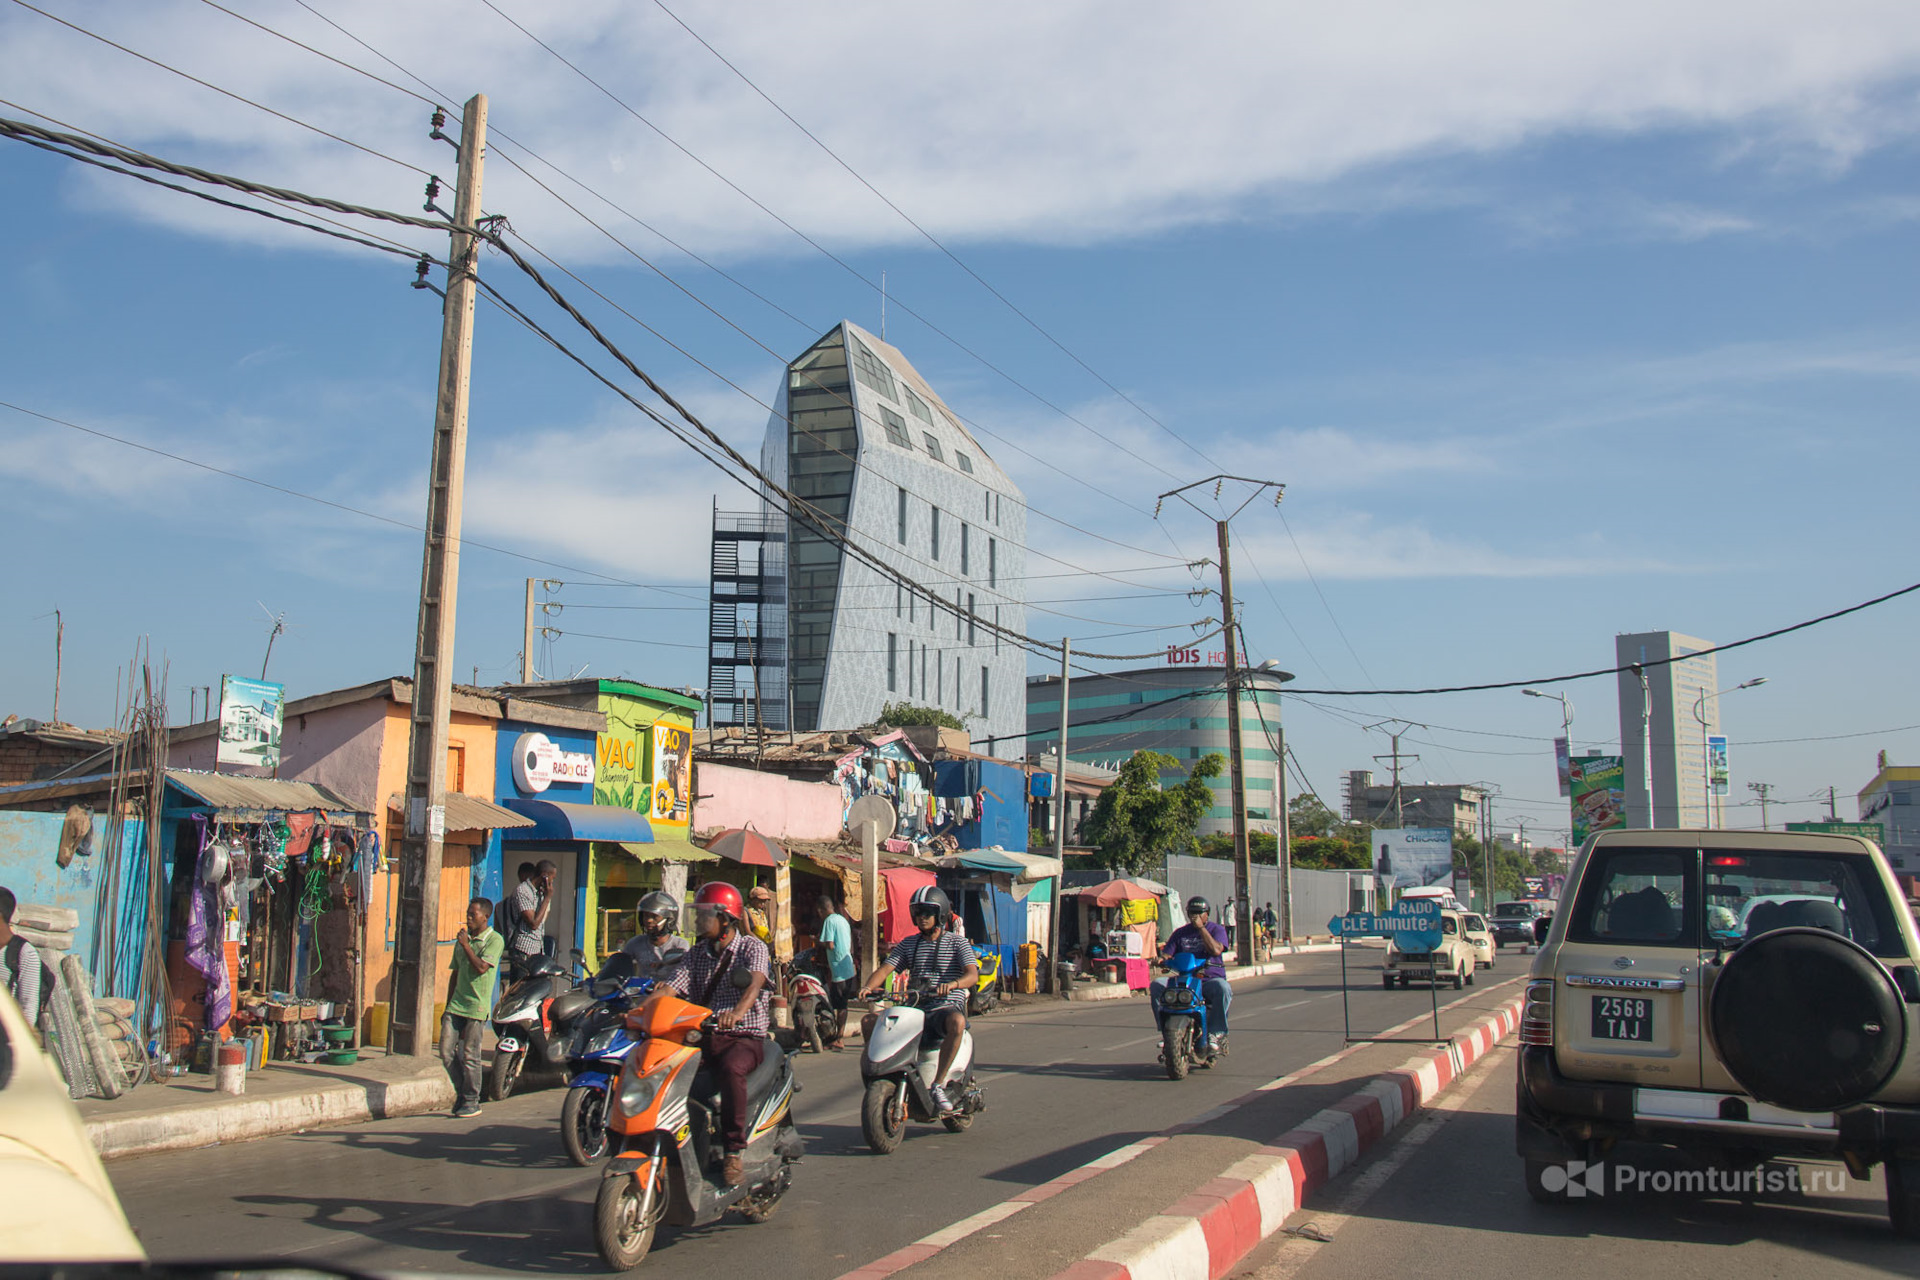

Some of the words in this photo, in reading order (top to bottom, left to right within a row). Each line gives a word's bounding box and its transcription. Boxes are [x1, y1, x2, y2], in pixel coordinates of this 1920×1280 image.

[1207, 650, 1248, 665] HOEL
[656, 727, 680, 751] VAO
[596, 735, 635, 771] VAO
[552, 761, 574, 777] RADO
[575, 764, 588, 777] CLE
[1398, 902, 1434, 915] RADO
[1341, 917, 1369, 932] CLE
[1373, 916, 1428, 932] minute
[1589, 978, 1660, 989] PATROL
[1600, 997, 1645, 1019] 2568
[1607, 1019, 1640, 1039] TAJ
